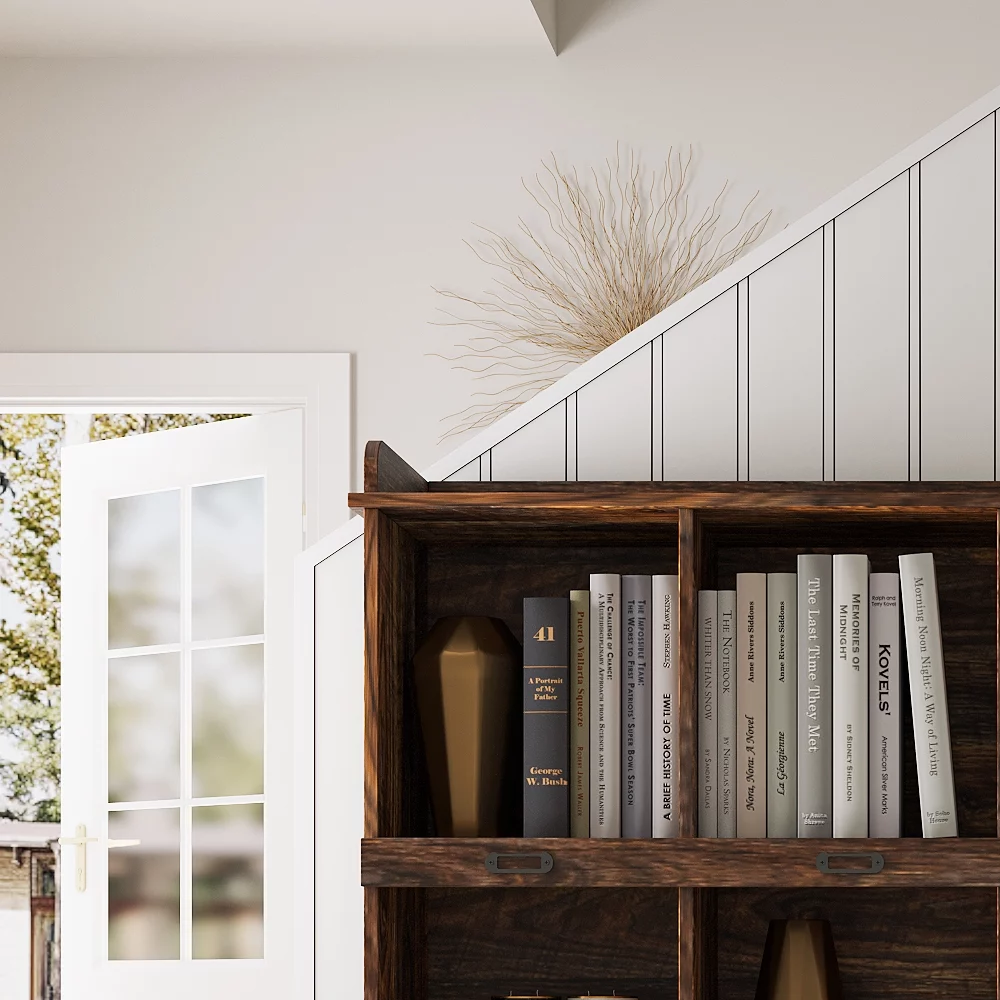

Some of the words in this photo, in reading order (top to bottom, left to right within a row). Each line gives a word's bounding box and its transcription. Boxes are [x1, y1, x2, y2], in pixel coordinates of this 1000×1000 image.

[808, 577, 820, 605] The
[913, 576, 926, 622] Morning
[533, 626, 555, 641] 41
[576, 611, 585, 644] Puerto
[704, 617, 712, 658] WHITER
[808, 609, 820, 641] Last
[839, 605, 848, 661] MIDNIGHT
[852, 594, 861, 653] MEMORIES
[918, 625, 929, 653] Noon
[576, 647, 585, 685] Vallarta
[704, 660, 712, 690] THAN
[808, 645, 820, 682] Time
[852, 656, 860, 672] OF
[919, 656, 933, 690] Night:
[575, 688, 585, 728] Squeeze
[663, 694, 671, 717] TIME
[704, 691, 713, 721] SNOW
[806, 685, 821, 720] They
[924, 692, 934, 701] A
[663, 720, 672, 734] OF
[924, 703, 937, 726] Way
[808, 724, 820, 753] Met
[927, 728, 938, 742] of
[663, 737, 672, 779] HISTORY
[881, 735, 889, 772] American
[928, 742, 940, 777] Living
[530, 767, 563, 776] George
[542, 777, 567, 785] Bush
[881, 773, 889, 792] Silver
[663, 782, 672, 809] BRIEF
[663, 812, 672, 821] A
